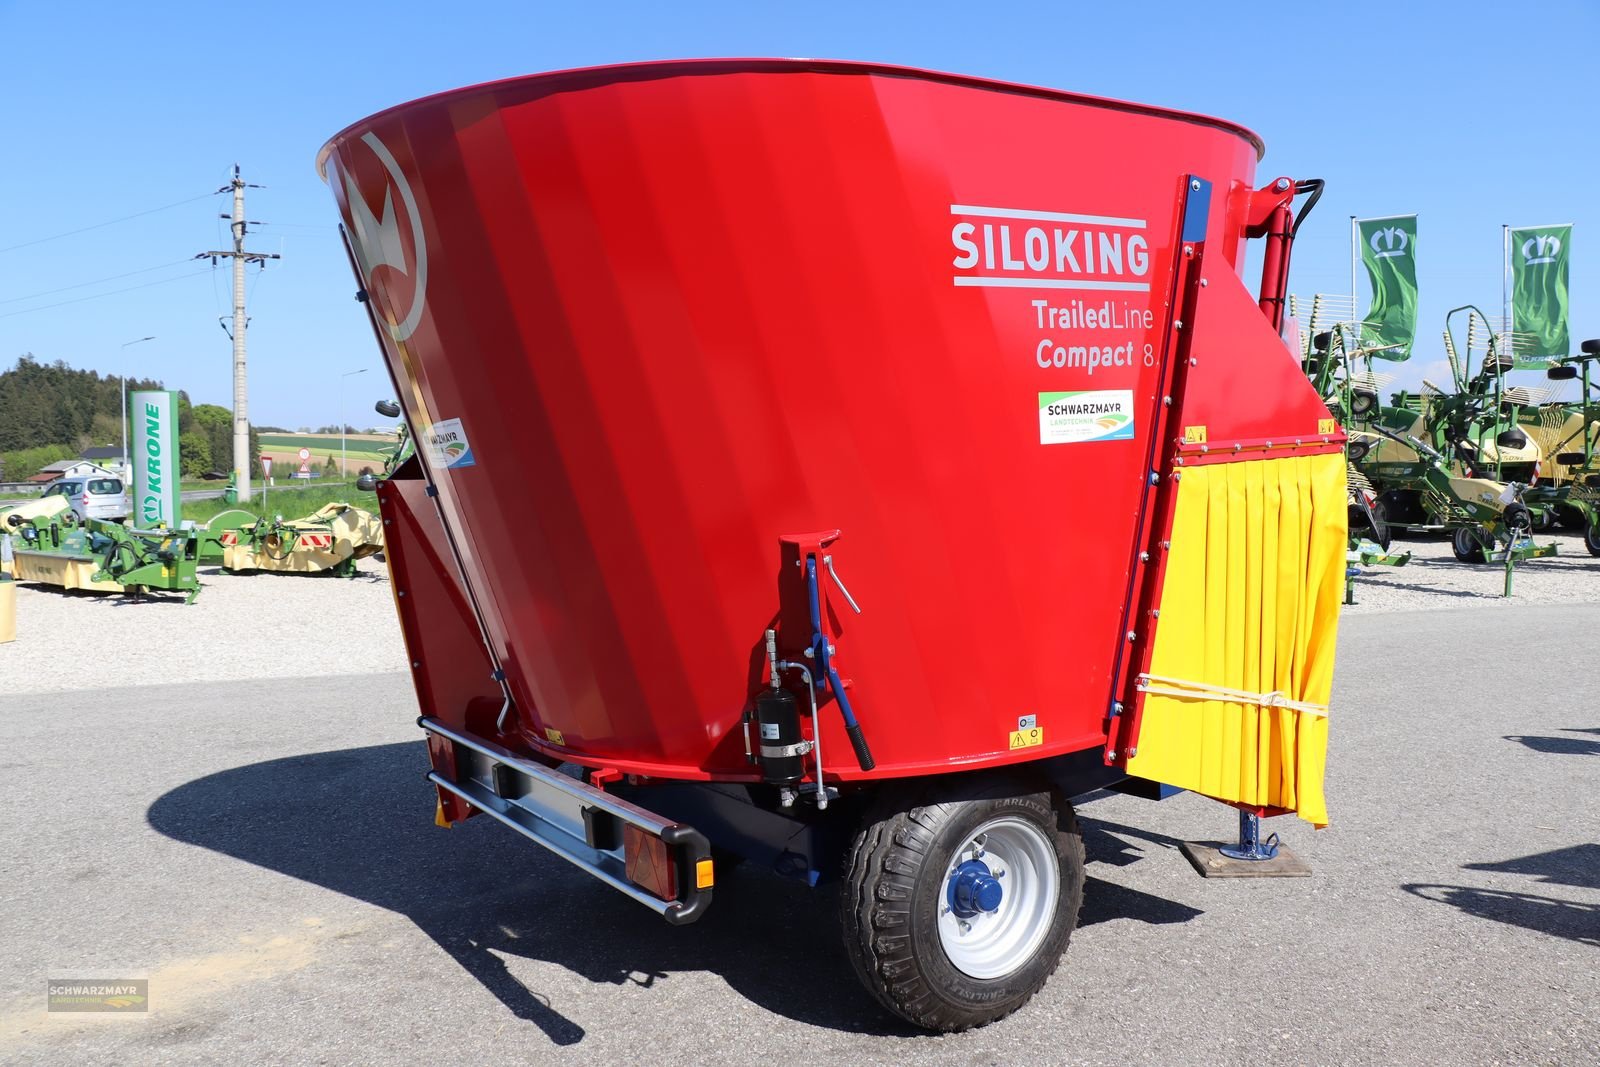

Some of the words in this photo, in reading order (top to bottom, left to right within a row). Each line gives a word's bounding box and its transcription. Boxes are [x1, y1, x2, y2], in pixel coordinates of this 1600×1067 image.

[952, 222, 1149, 276] SILOKING
[1032, 299, 1154, 329] TrailedLine
[1036, 339, 1134, 375] Compact
[1143, 344, 1154, 367] 8
[1048, 402, 1121, 416] SCHWARZMAYR
[1050, 418, 1094, 426] LANDTECHNIK
[145, 402, 162, 494] KRONE
